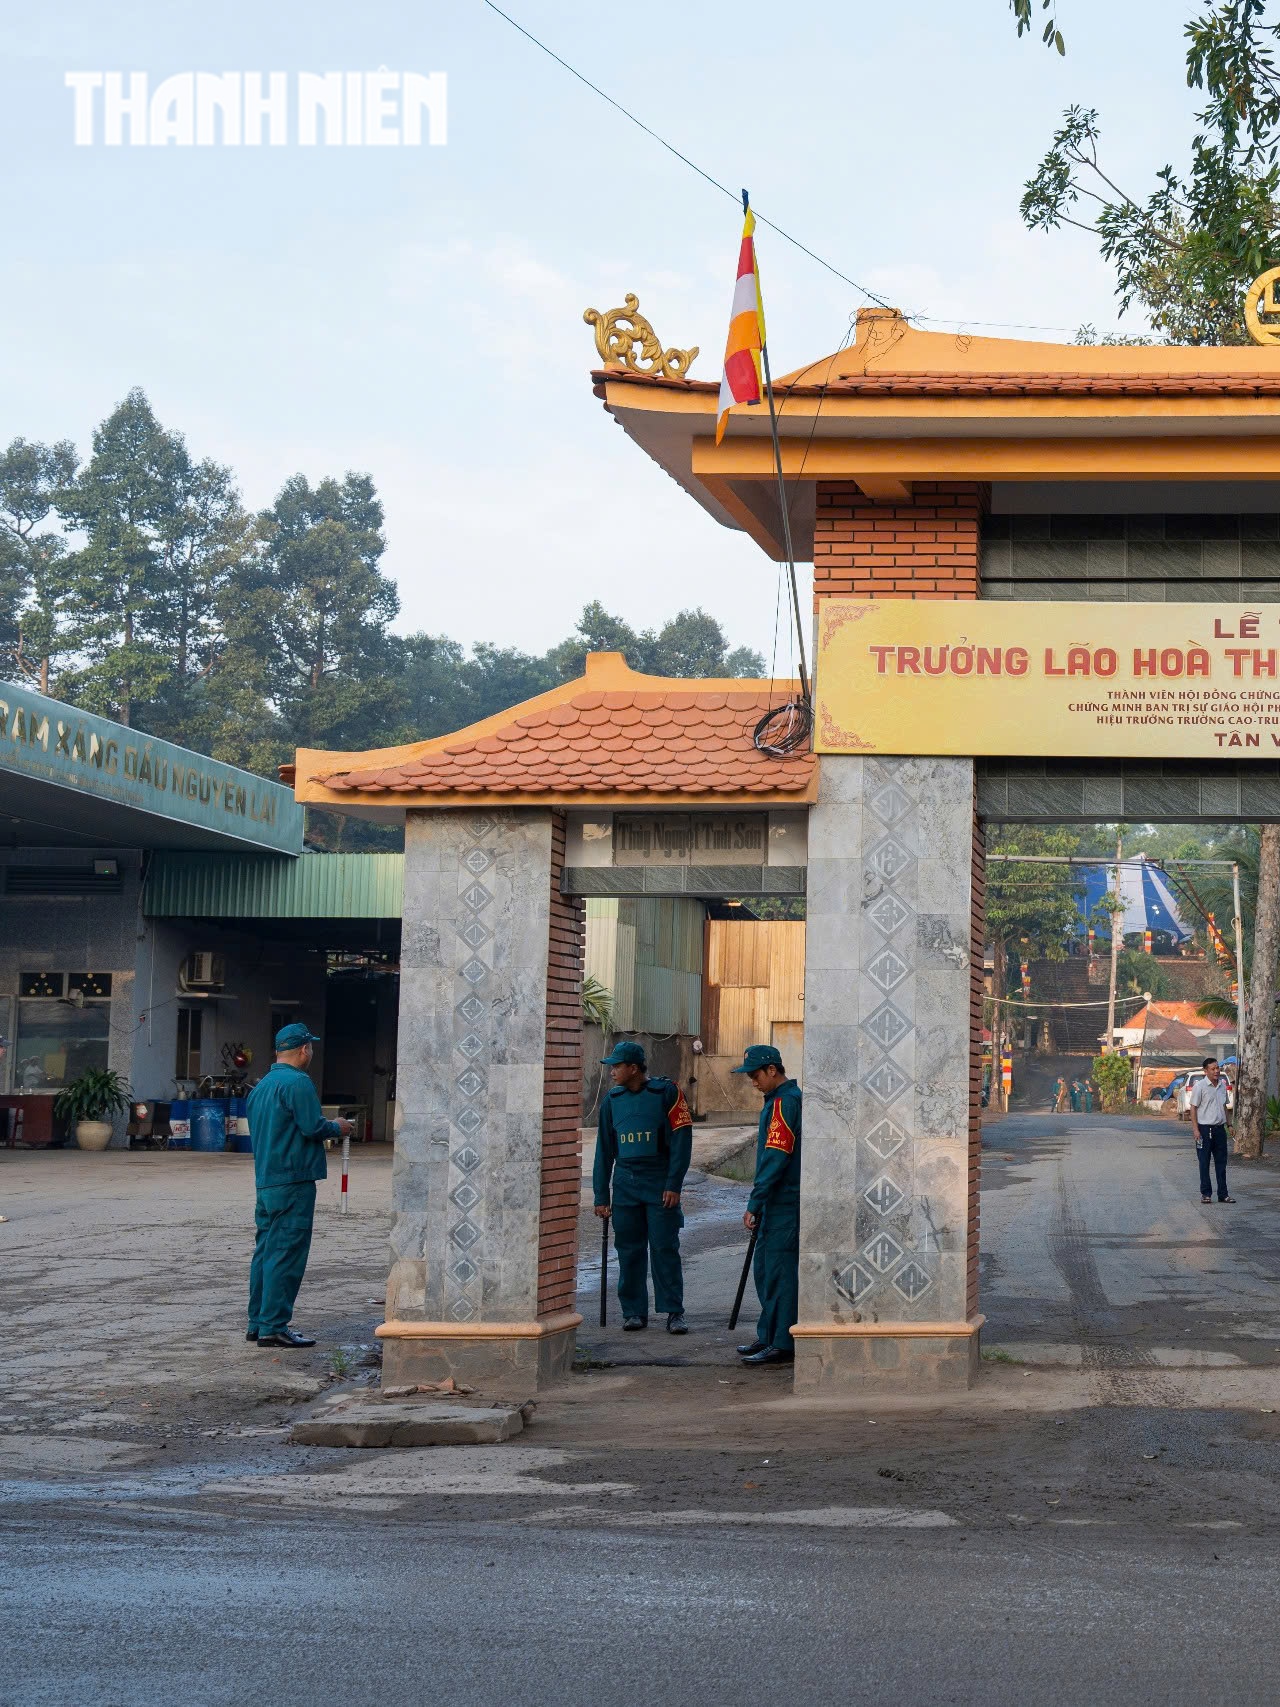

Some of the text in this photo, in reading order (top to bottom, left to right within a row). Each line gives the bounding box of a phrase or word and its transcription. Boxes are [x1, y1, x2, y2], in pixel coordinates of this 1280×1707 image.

[1215, 612, 1262, 638] LỄ
[869, 636, 1029, 676] TRƯỞNG
[1044, 642, 1117, 677] LÃO
[1133, 640, 1209, 677] HOÀ
[1107, 689, 1146, 700] THÀNH
[1150, 689, 1175, 700] VIÊN
[1179, 689, 1200, 702] HỘI
[1203, 688, 1237, 700] ĐỒNG
[1240, 689, 1280, 700] CHỨNG
[1068, 701, 1109, 712] CHỨNG
[1112, 703, 1142, 712] MINH
[1146, 703, 1169, 712] BAN
[1172, 703, 1190, 714] TRỊ
[1193, 703, 1209, 713] SỰ
[1211, 702, 1240, 713] GIÁO
[1243, 703, 1264, 715] HỘI
[1097, 714, 1122, 726] HIỆU
[1214, 730, 1260, 747] TÂN
[620, 1132, 651, 1143] DQTT
